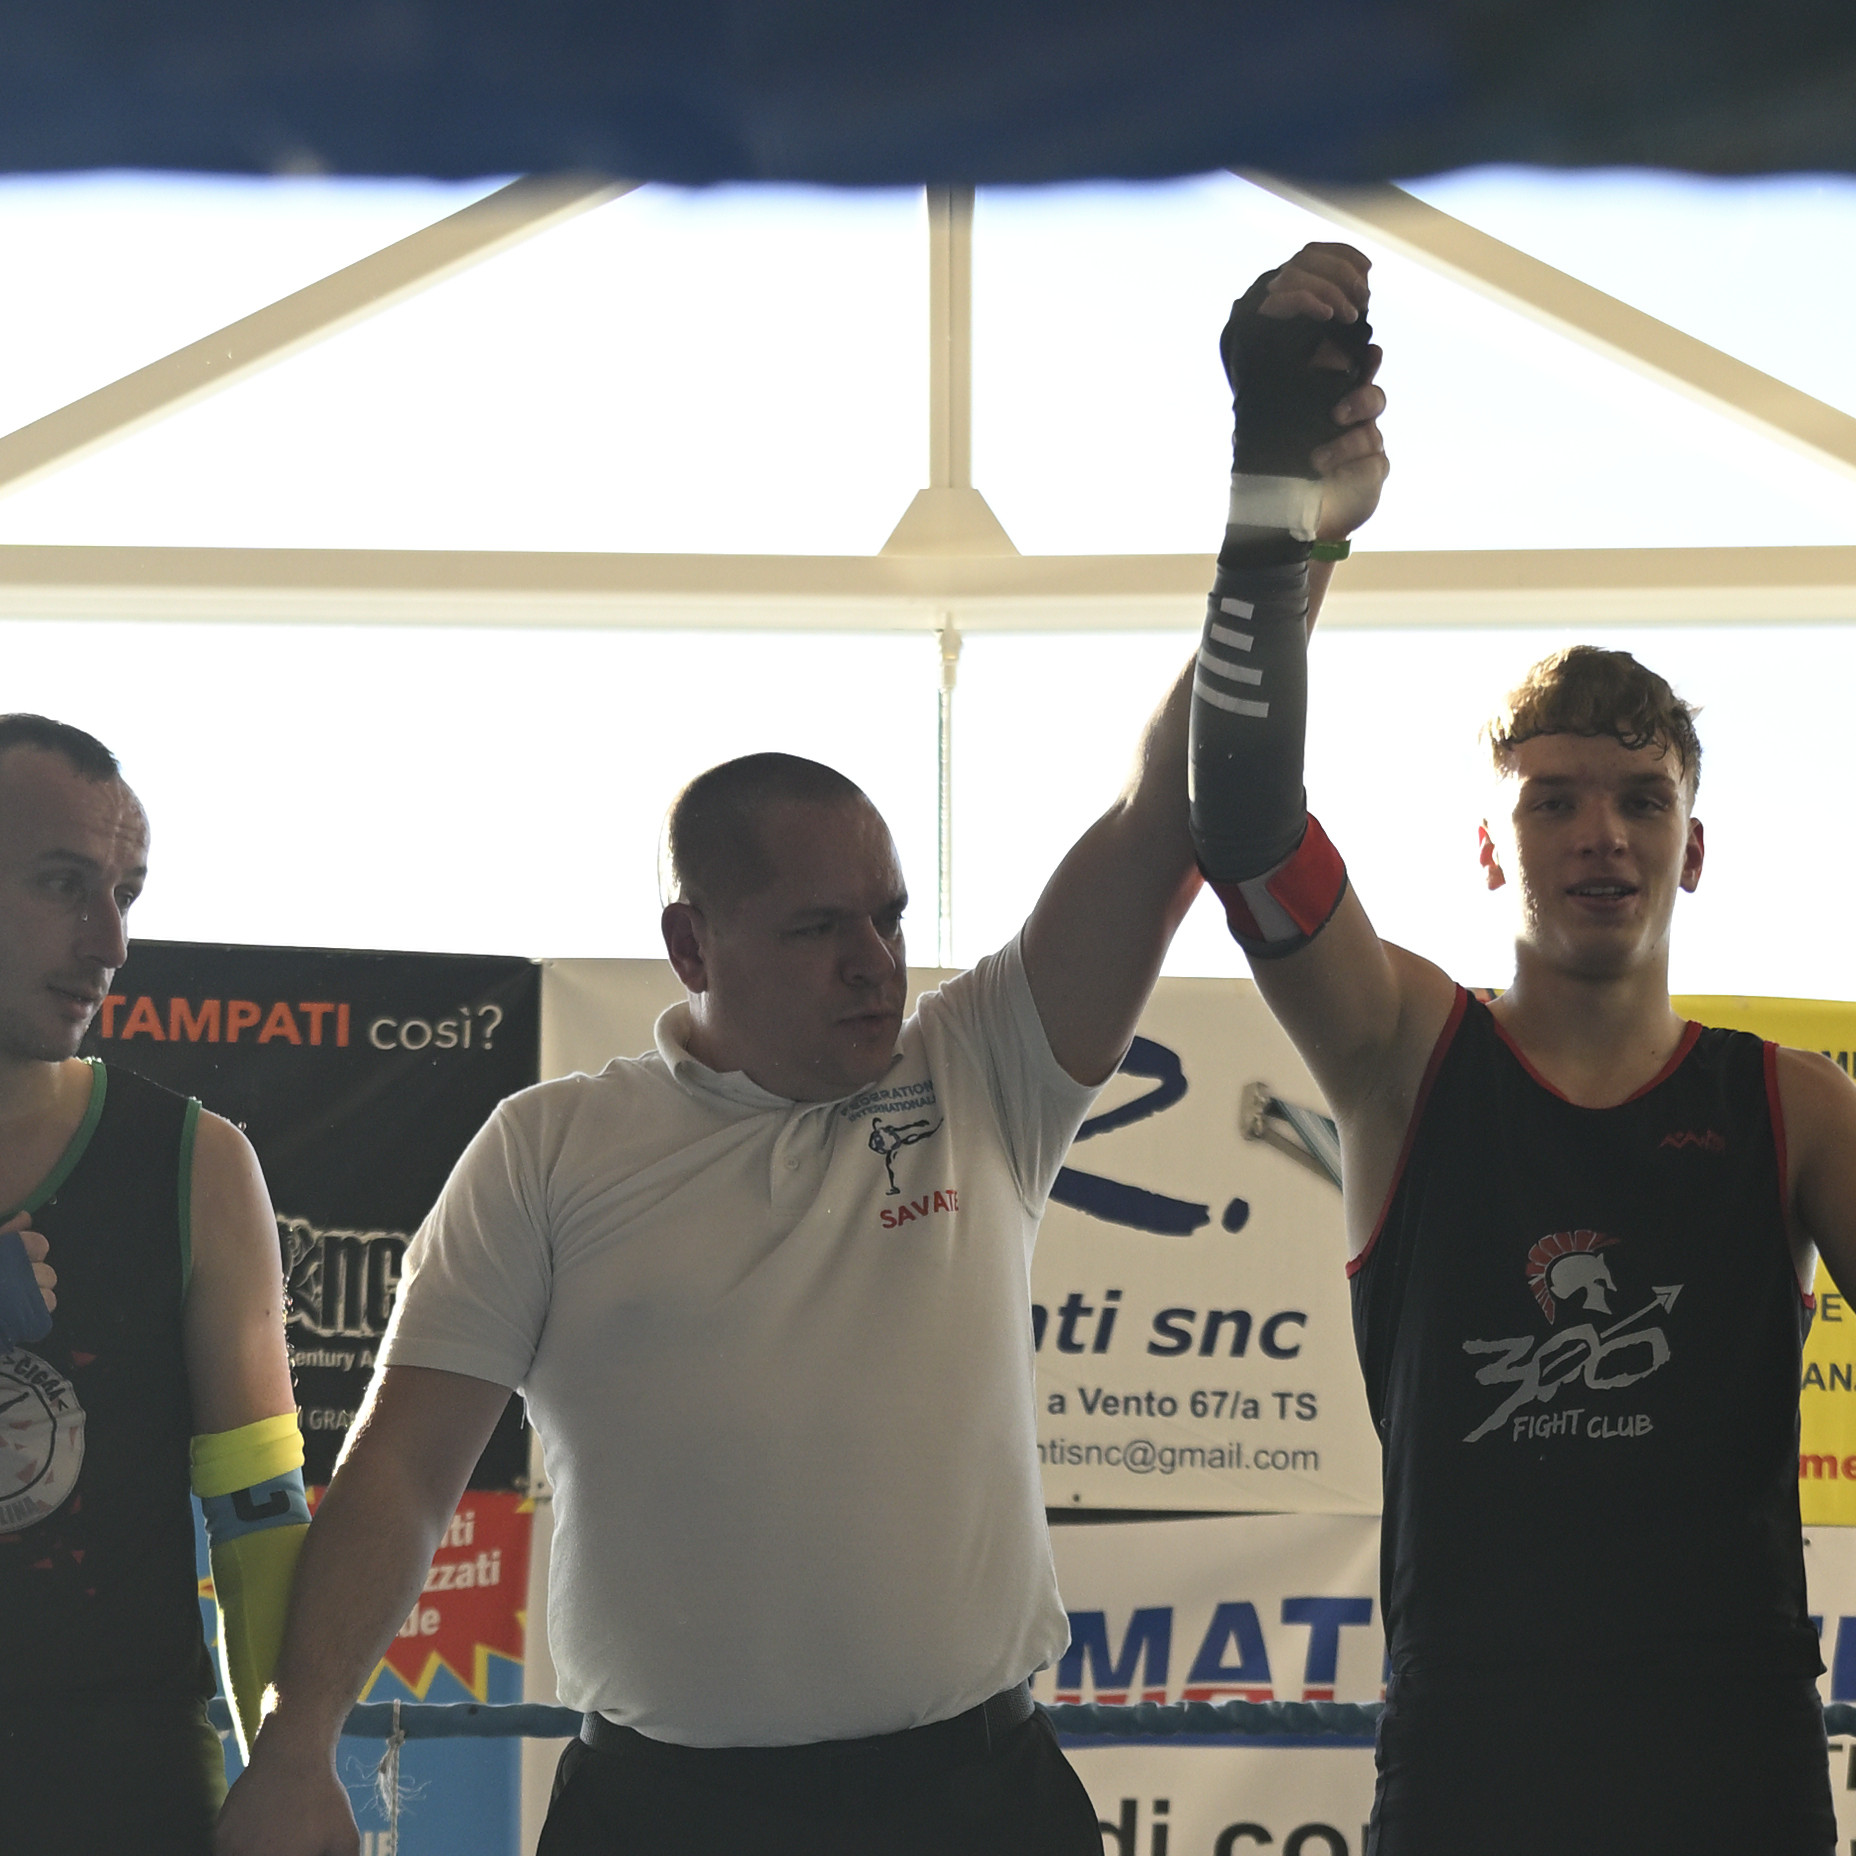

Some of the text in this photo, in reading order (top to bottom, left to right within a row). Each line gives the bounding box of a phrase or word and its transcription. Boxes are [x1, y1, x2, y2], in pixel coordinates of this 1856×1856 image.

[368, 1003, 504, 1051] così?
[879, 1189, 960, 1230] SAVATE
[1146, 1304, 1308, 1361] snc
[1078, 1387, 1178, 1419] Vento
[1189, 1389, 1261, 1420] 67/a
[1271, 1391, 1319, 1422] TS
[1461, 1323, 1671, 1443] 300
[1512, 1408, 1654, 1442] FIGHT CLUB
